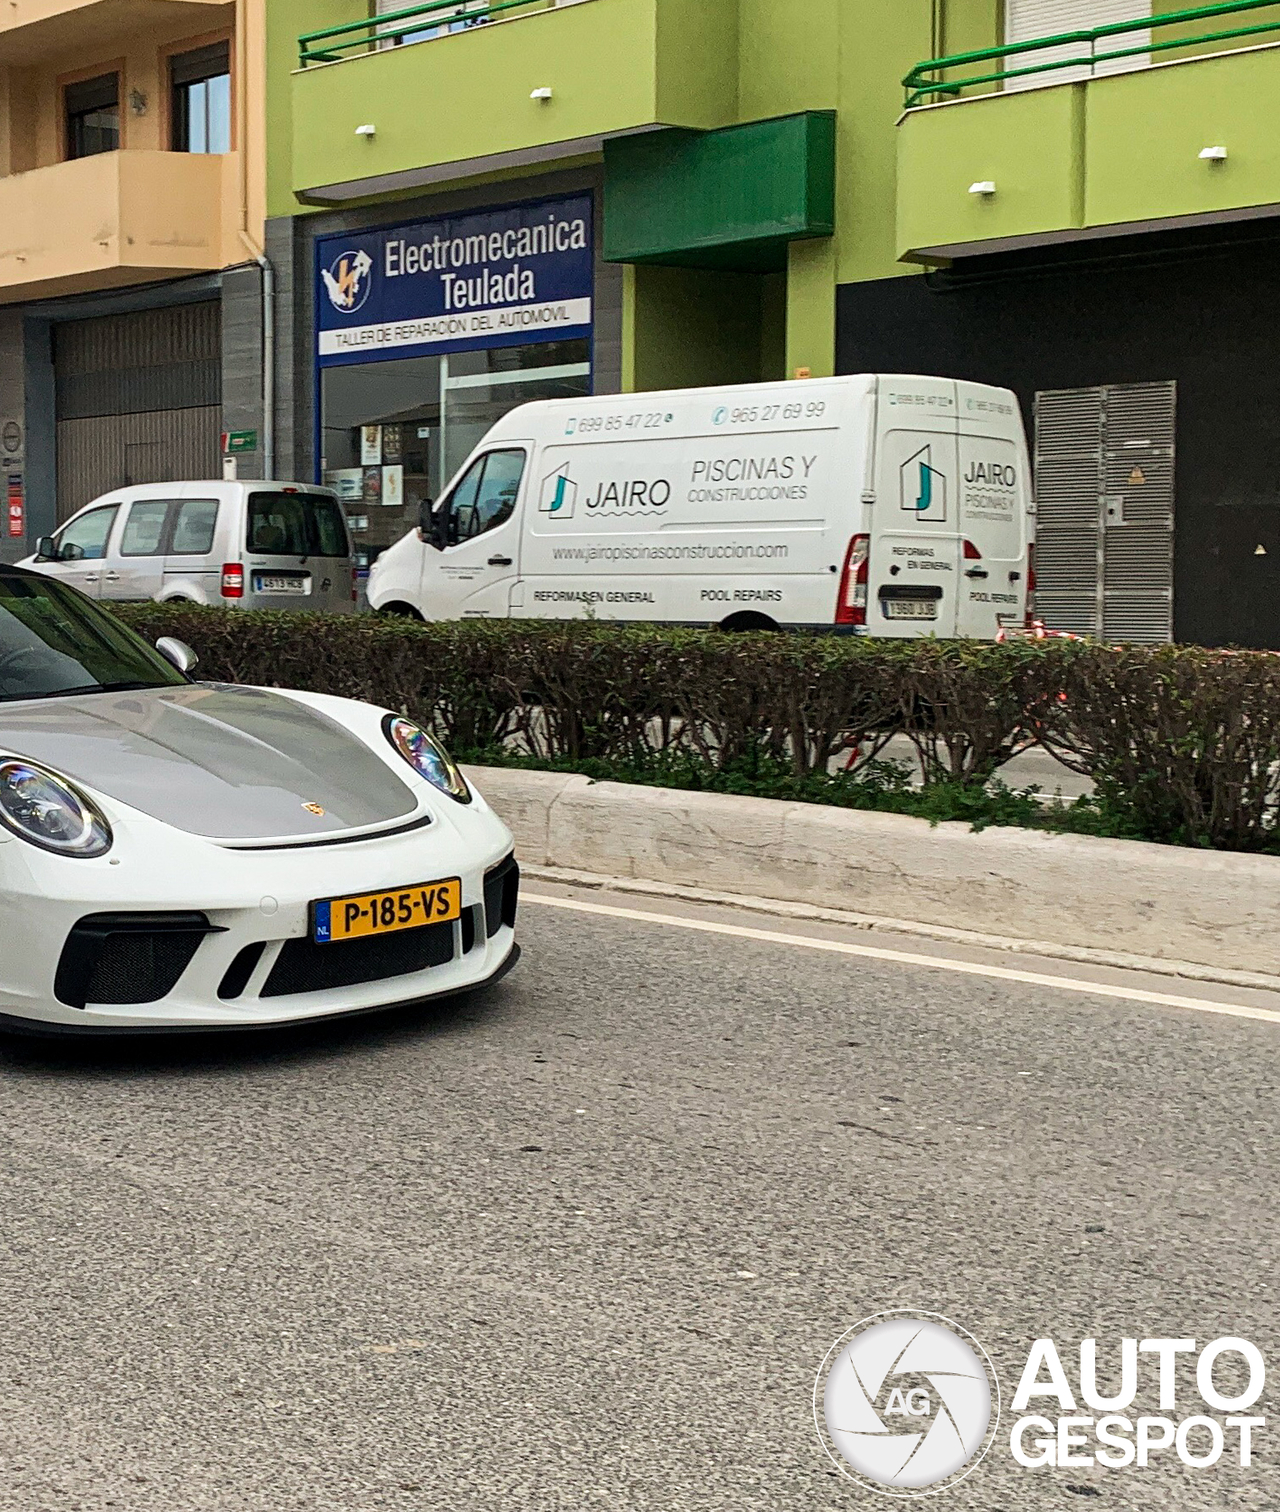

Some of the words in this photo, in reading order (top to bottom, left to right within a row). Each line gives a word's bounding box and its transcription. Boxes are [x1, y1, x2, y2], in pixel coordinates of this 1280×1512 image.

[384, 214, 586, 278] Electromecanica
[440, 264, 536, 310] Teulada
[335, 328, 376, 348] TALLER
[376, 325, 393, 343] DE
[471, 318, 494, 332] DEL
[578, 416, 602, 432] 699
[605, 414, 622, 431] 85
[626, 415, 641, 429] 47
[644, 412, 663, 428] 22
[730, 406, 758, 423] 965
[761, 404, 780, 421] 27
[783, 402, 802, 419] 69
[805, 401, 826, 417] 99
[691, 456, 795, 482] PISCINAS
[801, 455, 817, 477] Y
[964, 461, 1016, 487] JAIRO
[586, 478, 671, 508] JAIRO
[687, 485, 808, 503] CONSTRUCCIONES
[606, 592, 655, 604] GENERAL
[701, 589, 730, 602] POOL
[733, 589, 783, 602] REPAIRS
[345, 886, 450, 933] P-185-VS
[317, 926, 329, 936] NL
